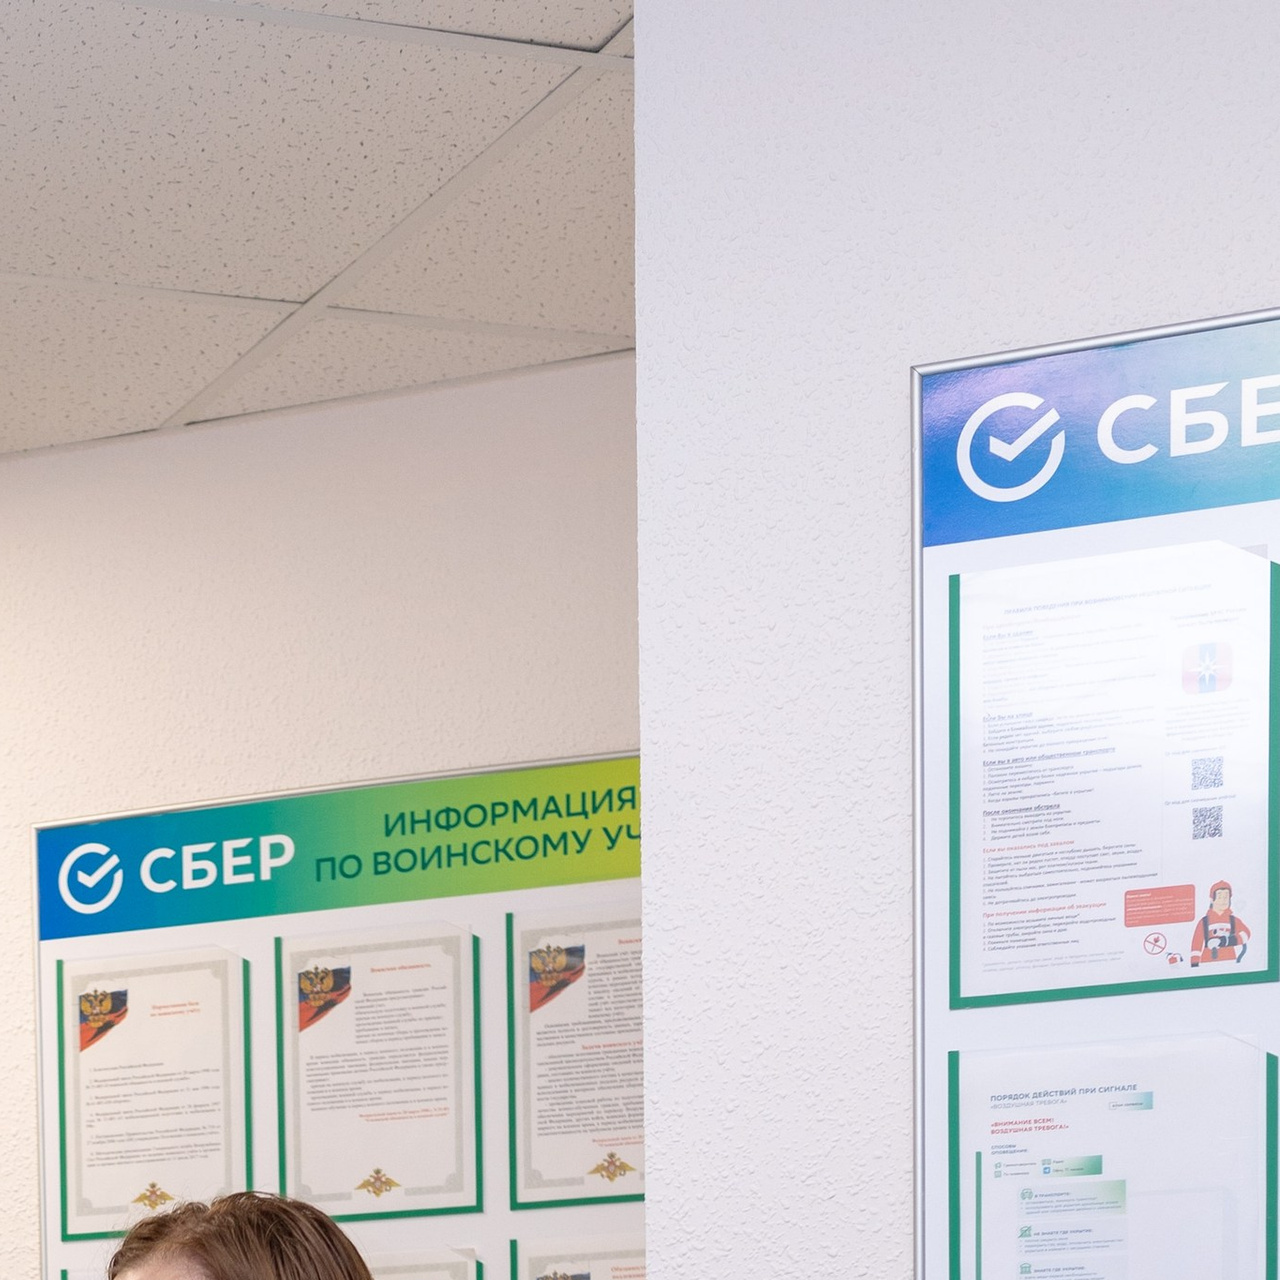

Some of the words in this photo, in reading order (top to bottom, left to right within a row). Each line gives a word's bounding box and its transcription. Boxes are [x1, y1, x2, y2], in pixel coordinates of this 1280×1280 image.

[382, 785, 638, 838] ИНФОРМАЦИЯ
[139, 832, 295, 894] СБЕР
[315, 855, 363, 884] ПО
[373, 828, 592, 876] ВОИНСКОМУ
[990, 1093, 1030, 1102] ПОРЯДОК
[1032, 1088, 1077, 1099] ДЕЙСТВИЙ
[1078, 1087, 1097, 1096] ПРИ
[1098, 1084, 1138, 1094] СИГНАЛЕ
